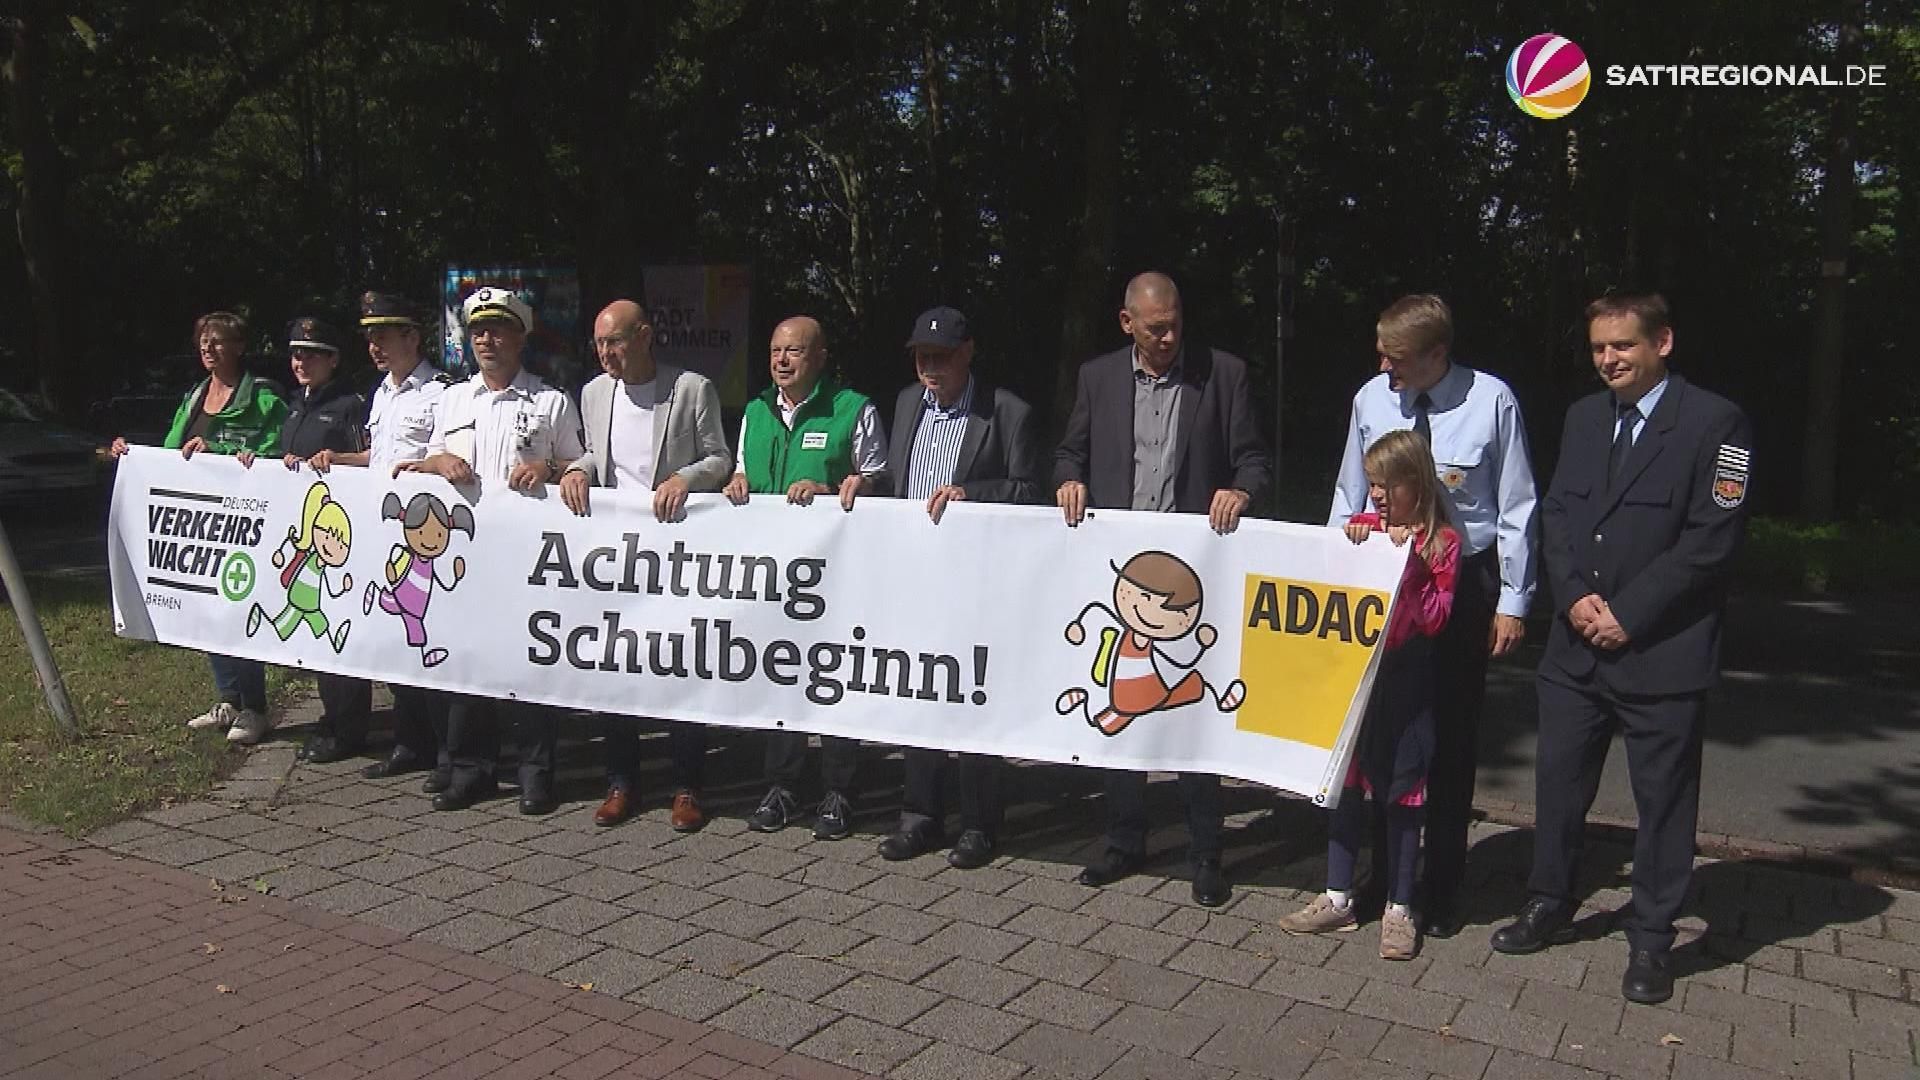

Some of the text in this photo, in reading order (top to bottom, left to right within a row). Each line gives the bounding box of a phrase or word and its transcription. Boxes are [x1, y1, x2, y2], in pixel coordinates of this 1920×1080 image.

[655, 328, 733, 347] OMMER
[223, 496, 270, 512] DEUTSCHE
[147, 504, 265, 547] VERKEHRS
[147, 538, 228, 577] WACHT
[528, 530, 826, 621] Achtung
[145, 592, 182, 609] BREMEN
[1247, 580, 1384, 647] ADAC
[527, 610, 989, 706] Schulbeginn!
